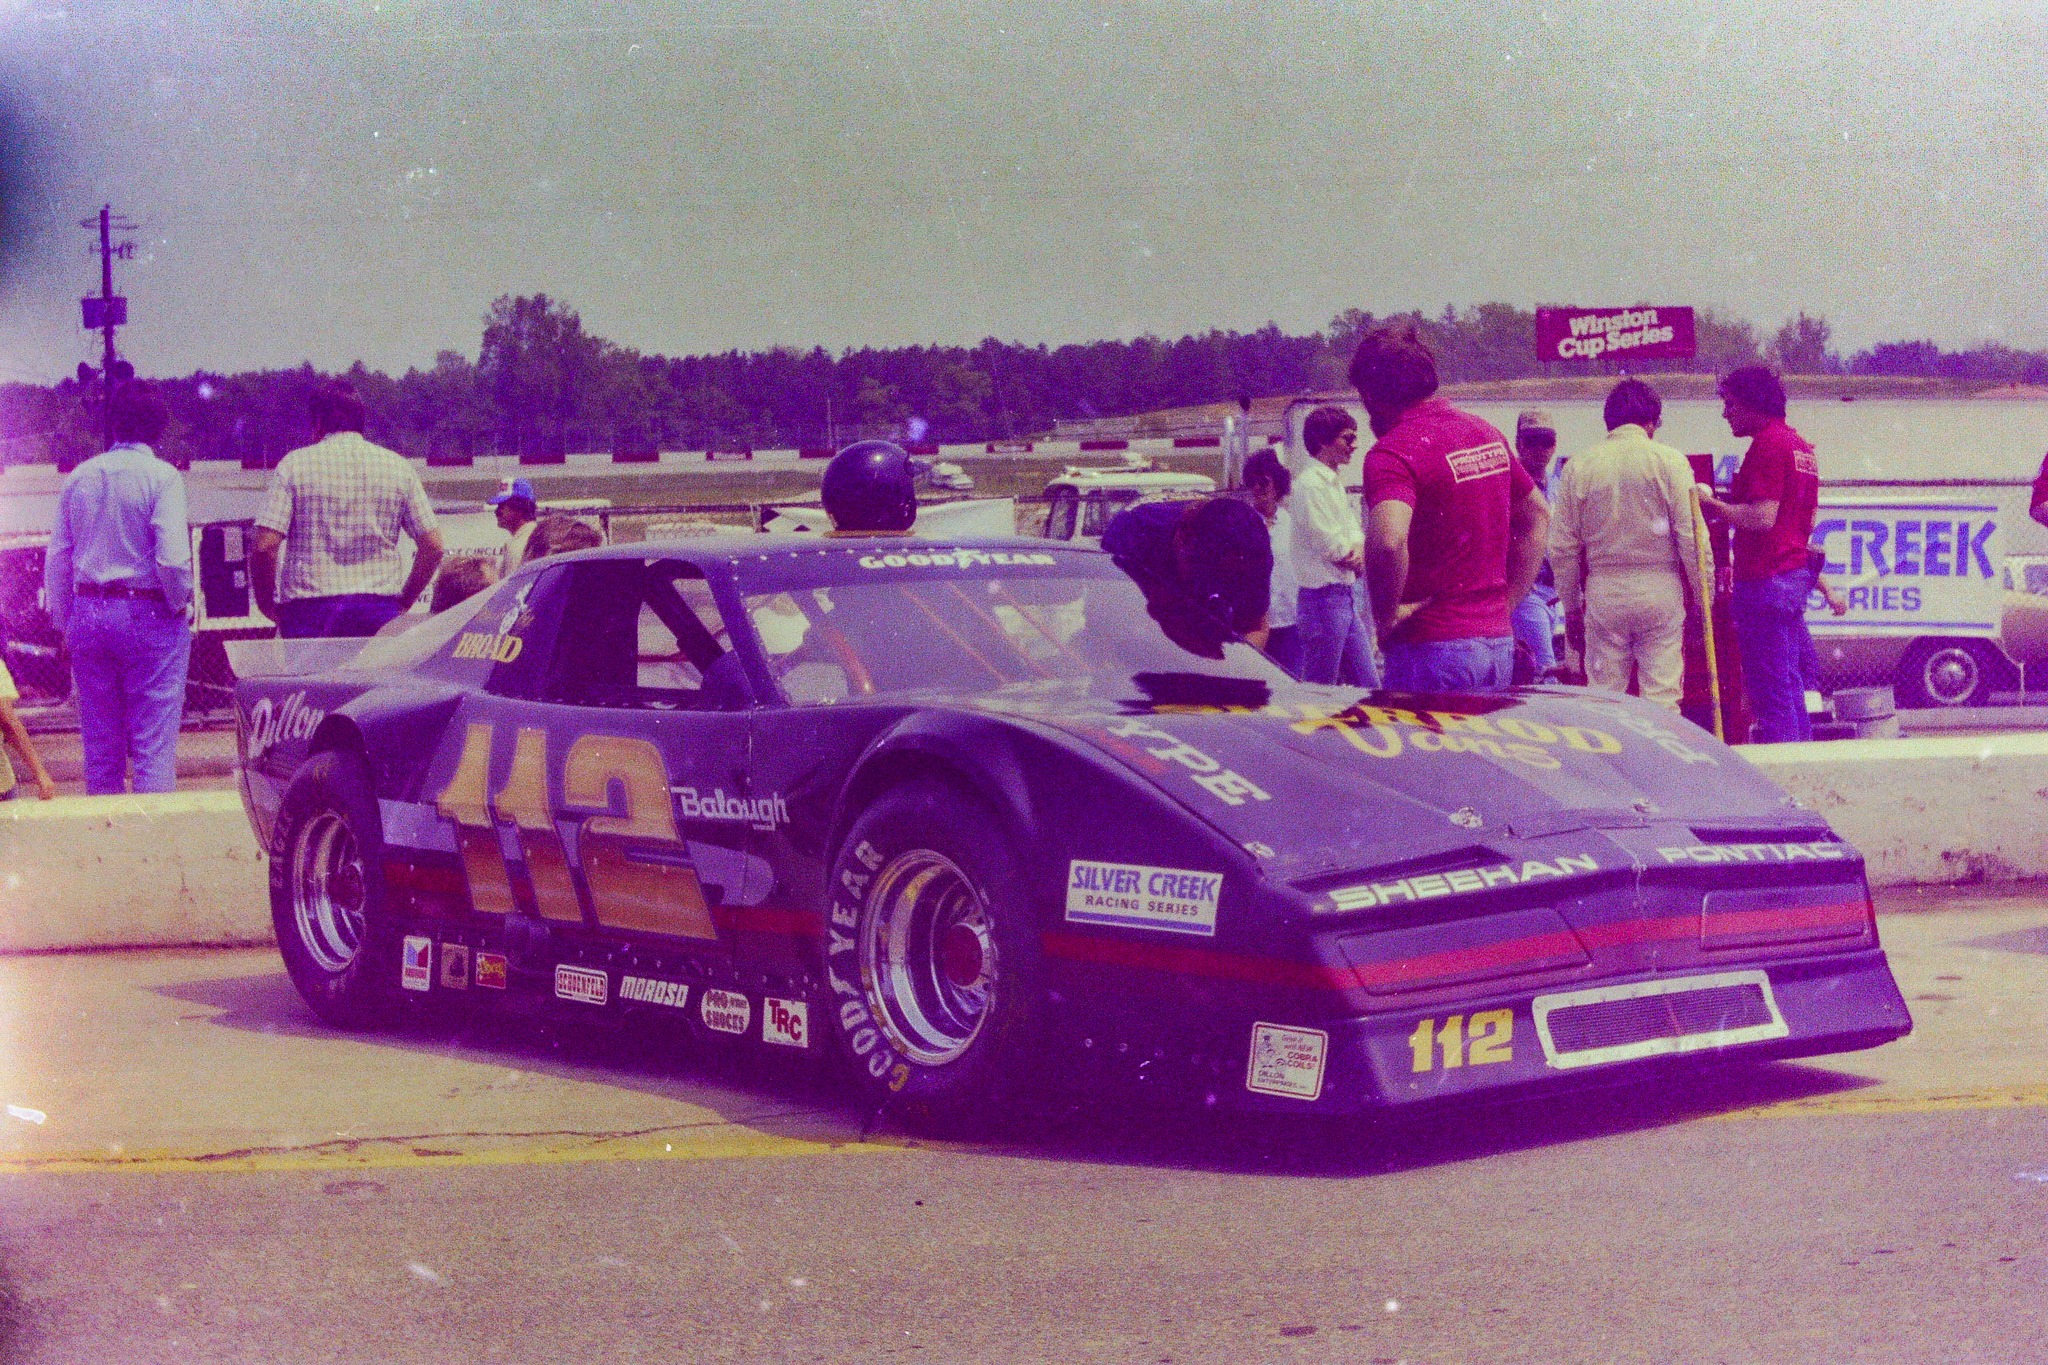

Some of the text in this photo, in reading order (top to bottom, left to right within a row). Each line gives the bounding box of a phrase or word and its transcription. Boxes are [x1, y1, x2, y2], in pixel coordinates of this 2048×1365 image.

[1558, 325, 1674, 358] Cup Series
[1569, 309, 1658, 336] Winston
[859, 549, 1057, 569] GOODYEAR
[1806, 518, 1997, 580] CREEK
[1805, 586, 1922, 611] SRIES
[670, 786, 790, 831] Balough
[437, 723, 719, 941] 112
[1656, 842, 1844, 863] PONTIAC
[1071, 865, 1217, 903] SILVER CREEK
[1328, 853, 1599, 912] SHEEHAN
[1085, 895, 1199, 916] RACING SERIES
[829, 840, 910, 1092] GOODYEAR
[619, 976, 689, 1007] MOROSO
[768, 999, 801, 1041] TRC
[1408, 1008, 1514, 1073] 112
